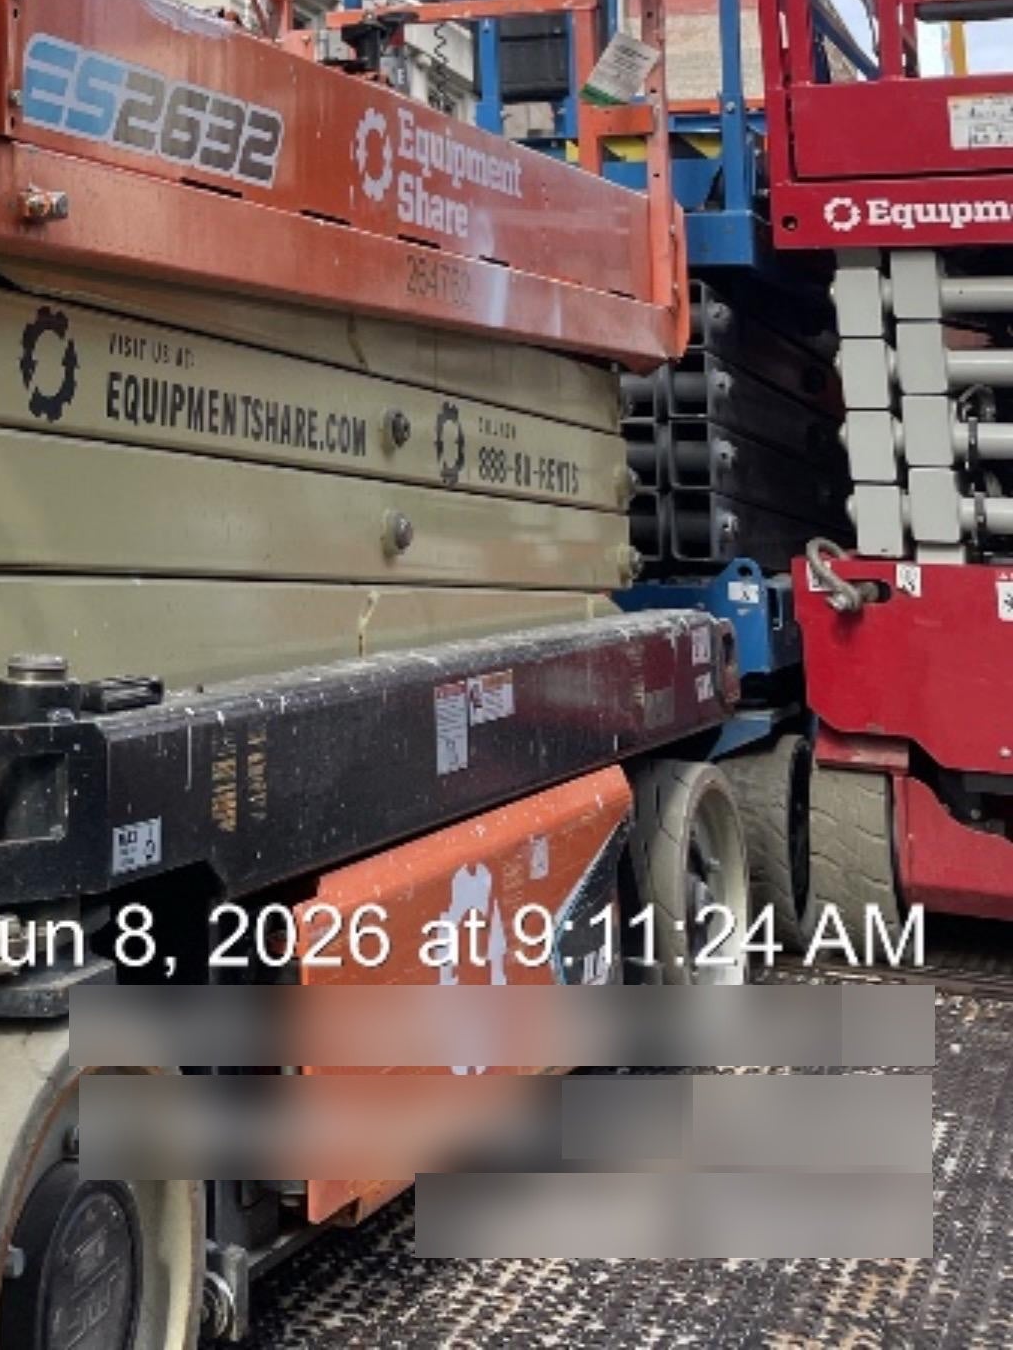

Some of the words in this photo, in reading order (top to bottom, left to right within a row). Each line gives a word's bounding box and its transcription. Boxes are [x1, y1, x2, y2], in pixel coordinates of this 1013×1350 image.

[22, 33, 285, 189] ES2632
[397, 106, 523, 199] Equipment
[397, 171, 469, 238] Share
[866, 198, 1013, 230] Equipm
[108, 332, 147, 361] VISIT
[106, 371, 367, 456] EQUIPMENTSHARE.COM
